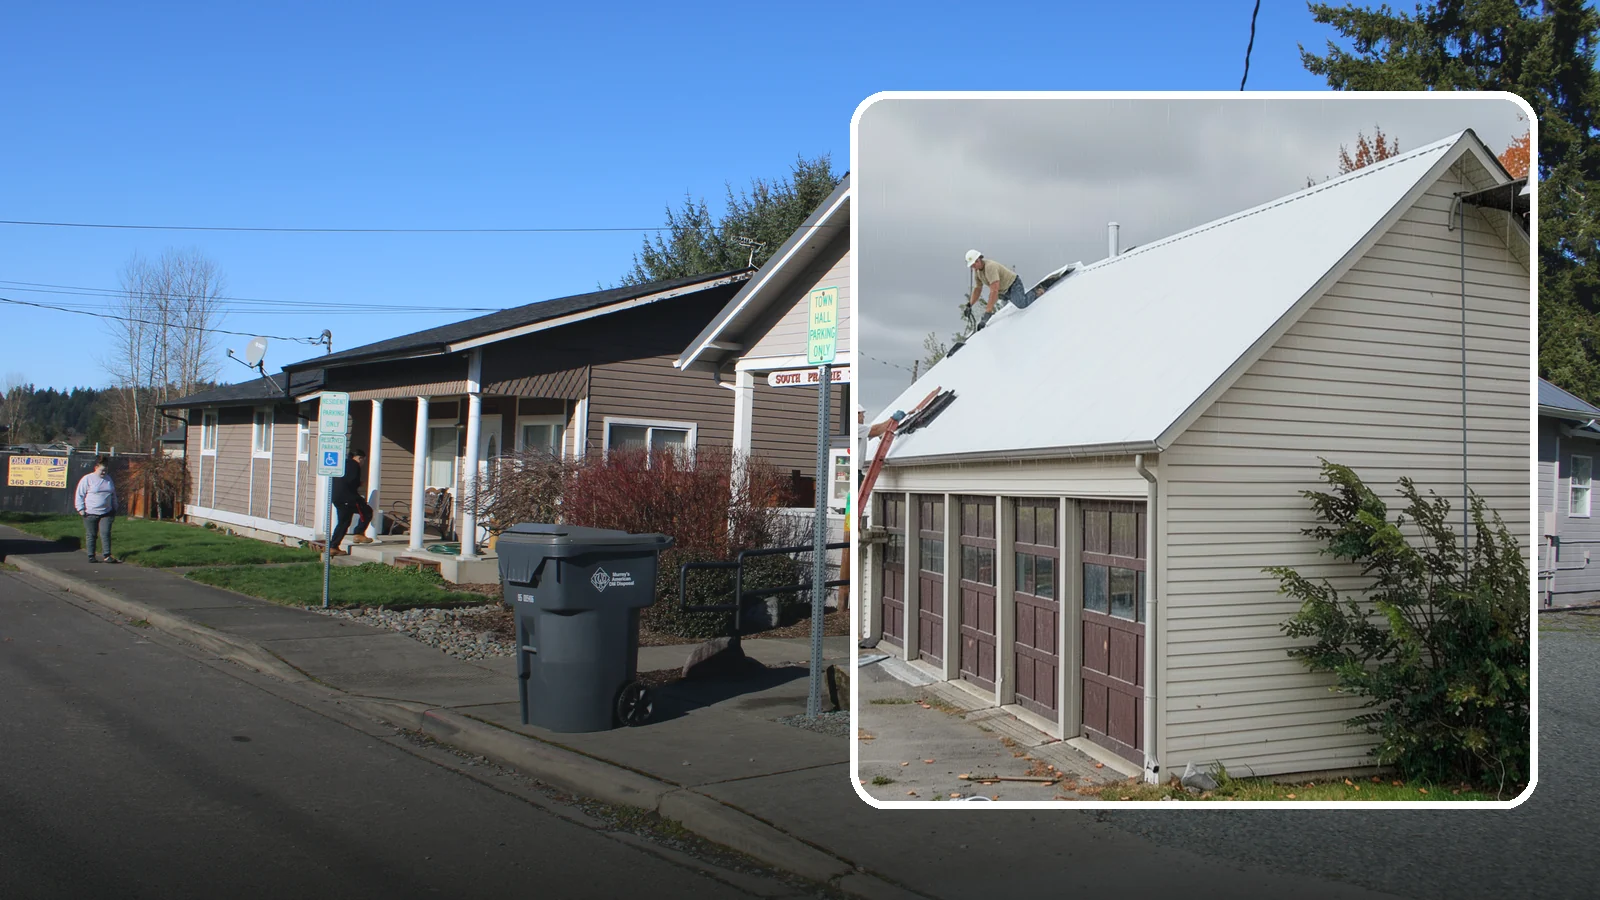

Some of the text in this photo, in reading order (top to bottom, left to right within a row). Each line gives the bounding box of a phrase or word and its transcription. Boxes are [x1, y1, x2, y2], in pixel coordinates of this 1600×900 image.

[815, 295, 832, 307] TOWN
[814, 311, 831, 324] HALL
[810, 326, 836, 340] PARKING
[813, 344, 831, 357] ONLY
[776, 373, 801, 384] SOUTH
